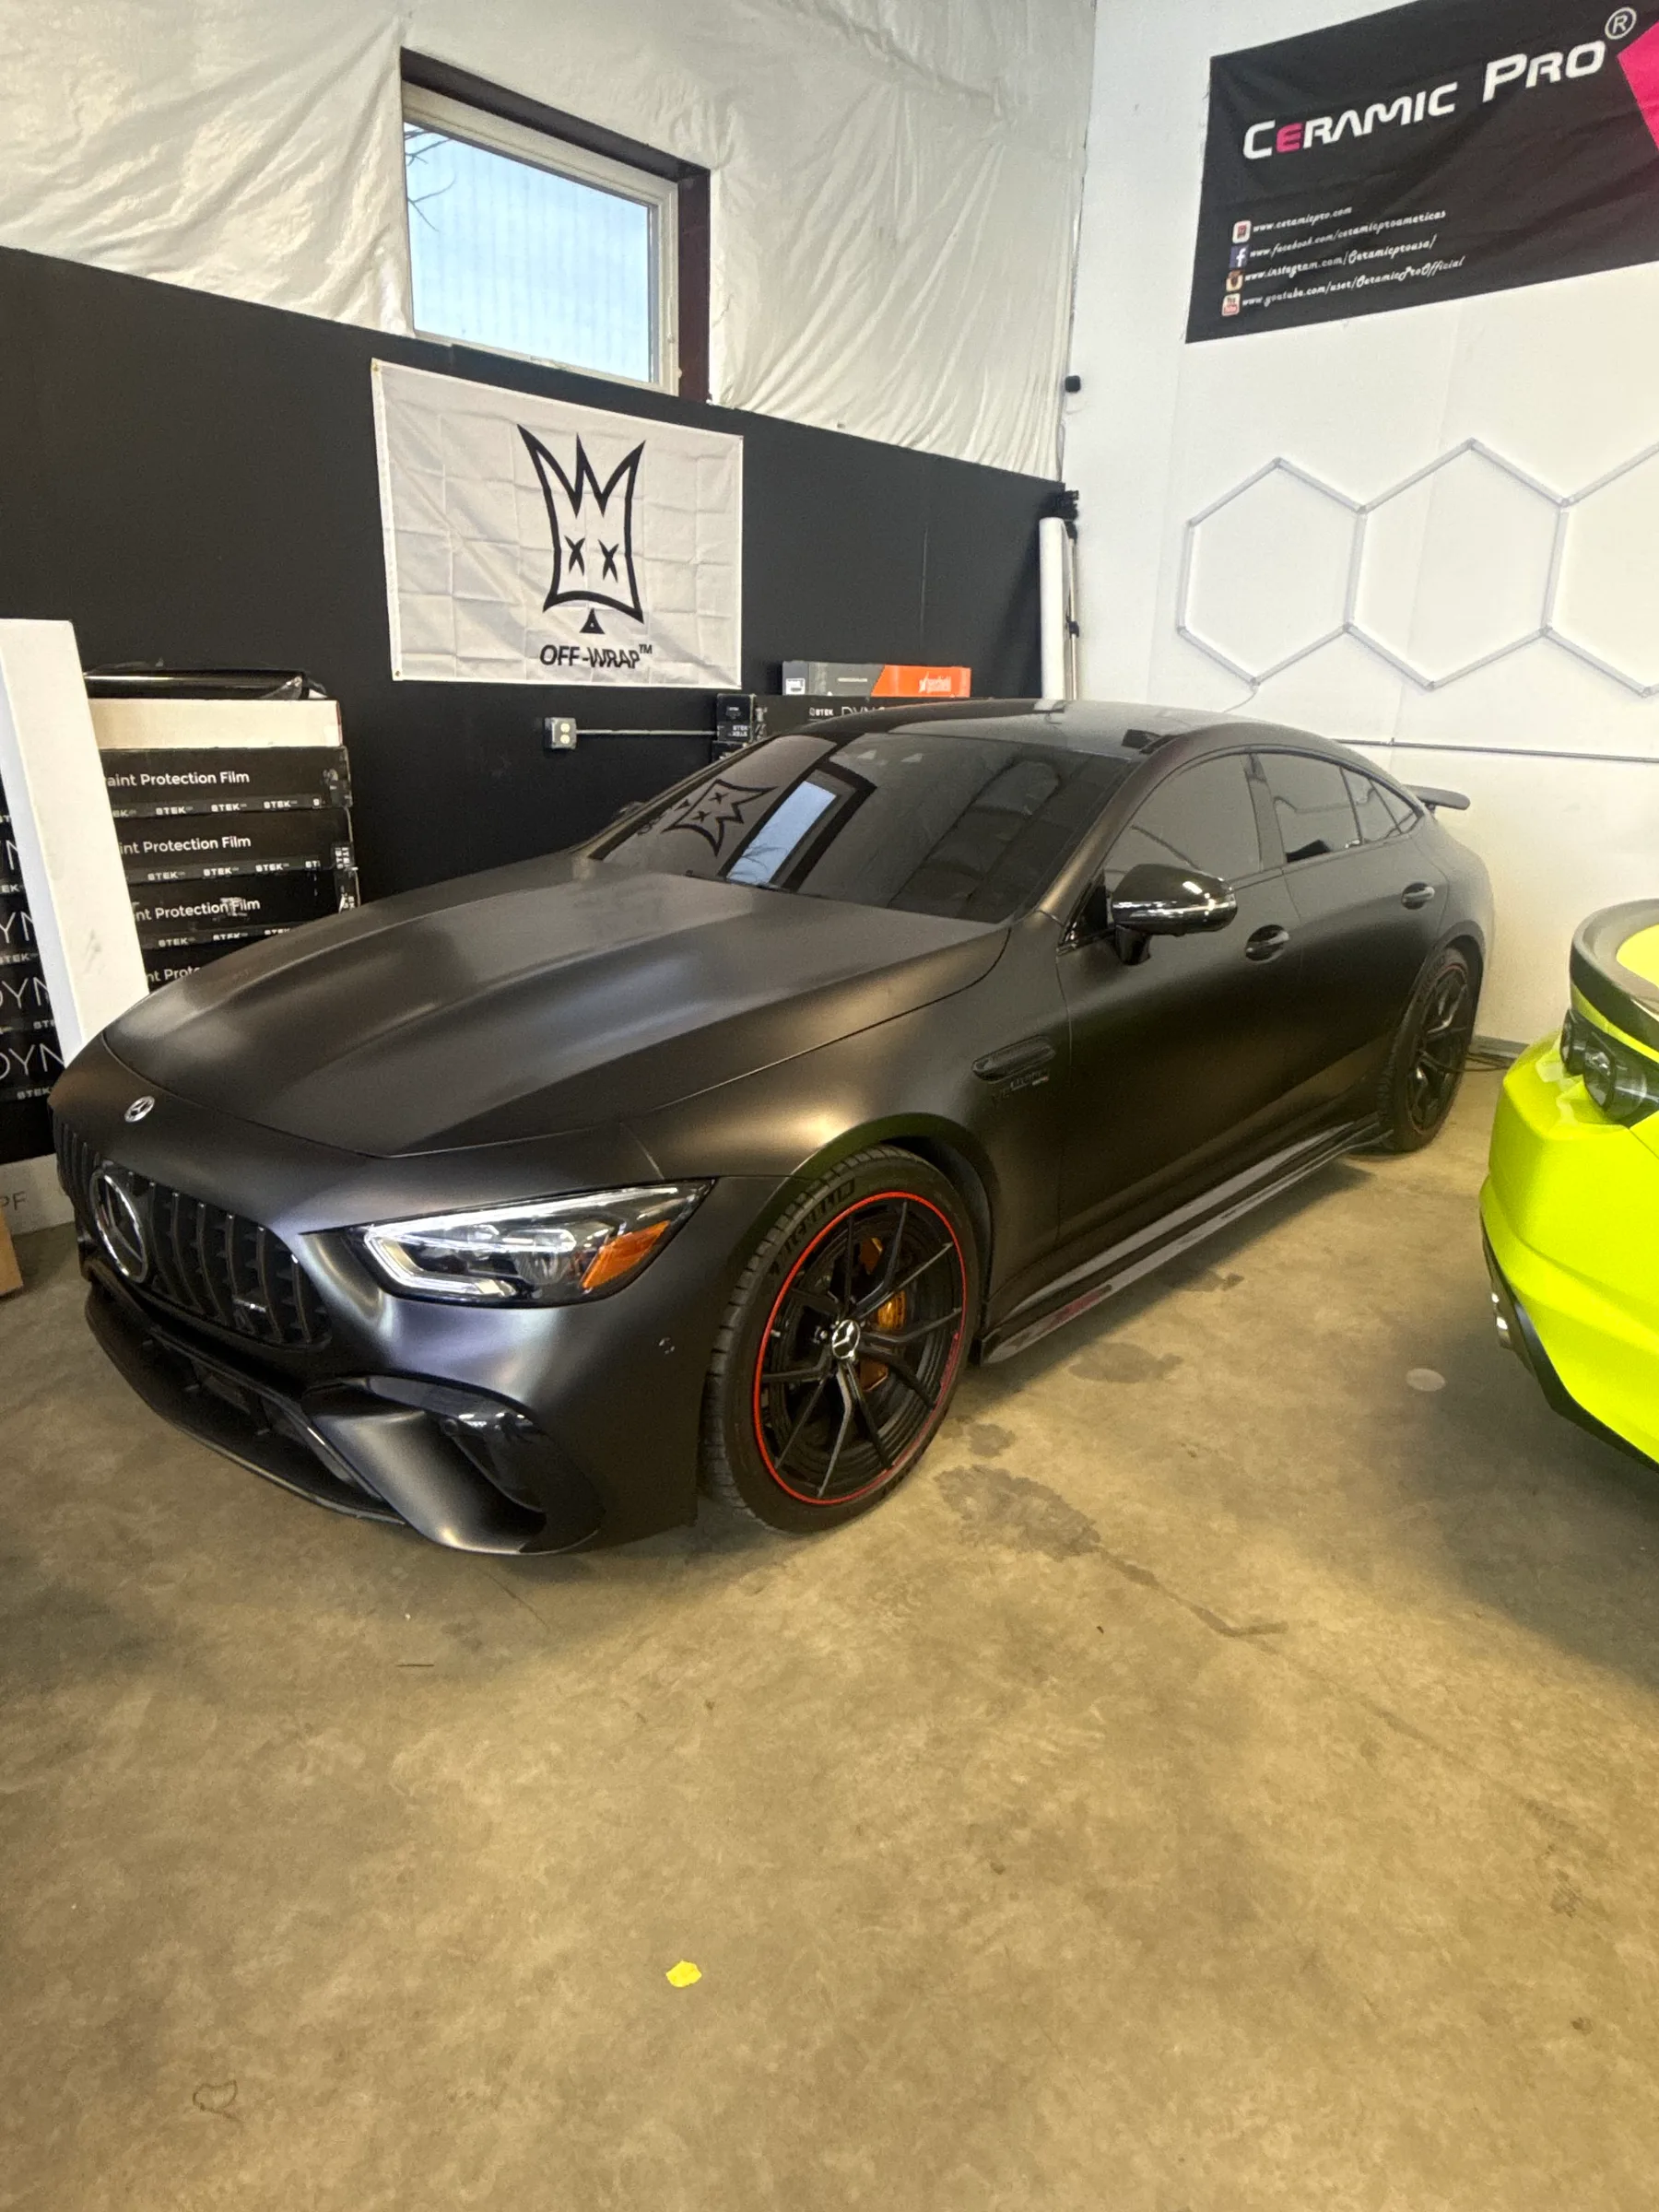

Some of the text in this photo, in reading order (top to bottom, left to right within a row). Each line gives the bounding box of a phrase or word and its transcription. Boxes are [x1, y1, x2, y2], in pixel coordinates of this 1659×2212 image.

[1253, 206, 1352, 232] www.ceramicpro.com
[104, 771, 251, 786] aint Protection Film
[211, 803, 241, 812] STEK
[264, 800, 291, 809] STEK
[143, 838, 218, 853] Protection
[221, 836, 252, 849] Film
[204, 867, 232, 877] STEK
[255, 864, 284, 872] STEK
[155, 901, 229, 920] Protection
[230, 899, 261, 912] Film
[164, 966, 201, 981] Prot
